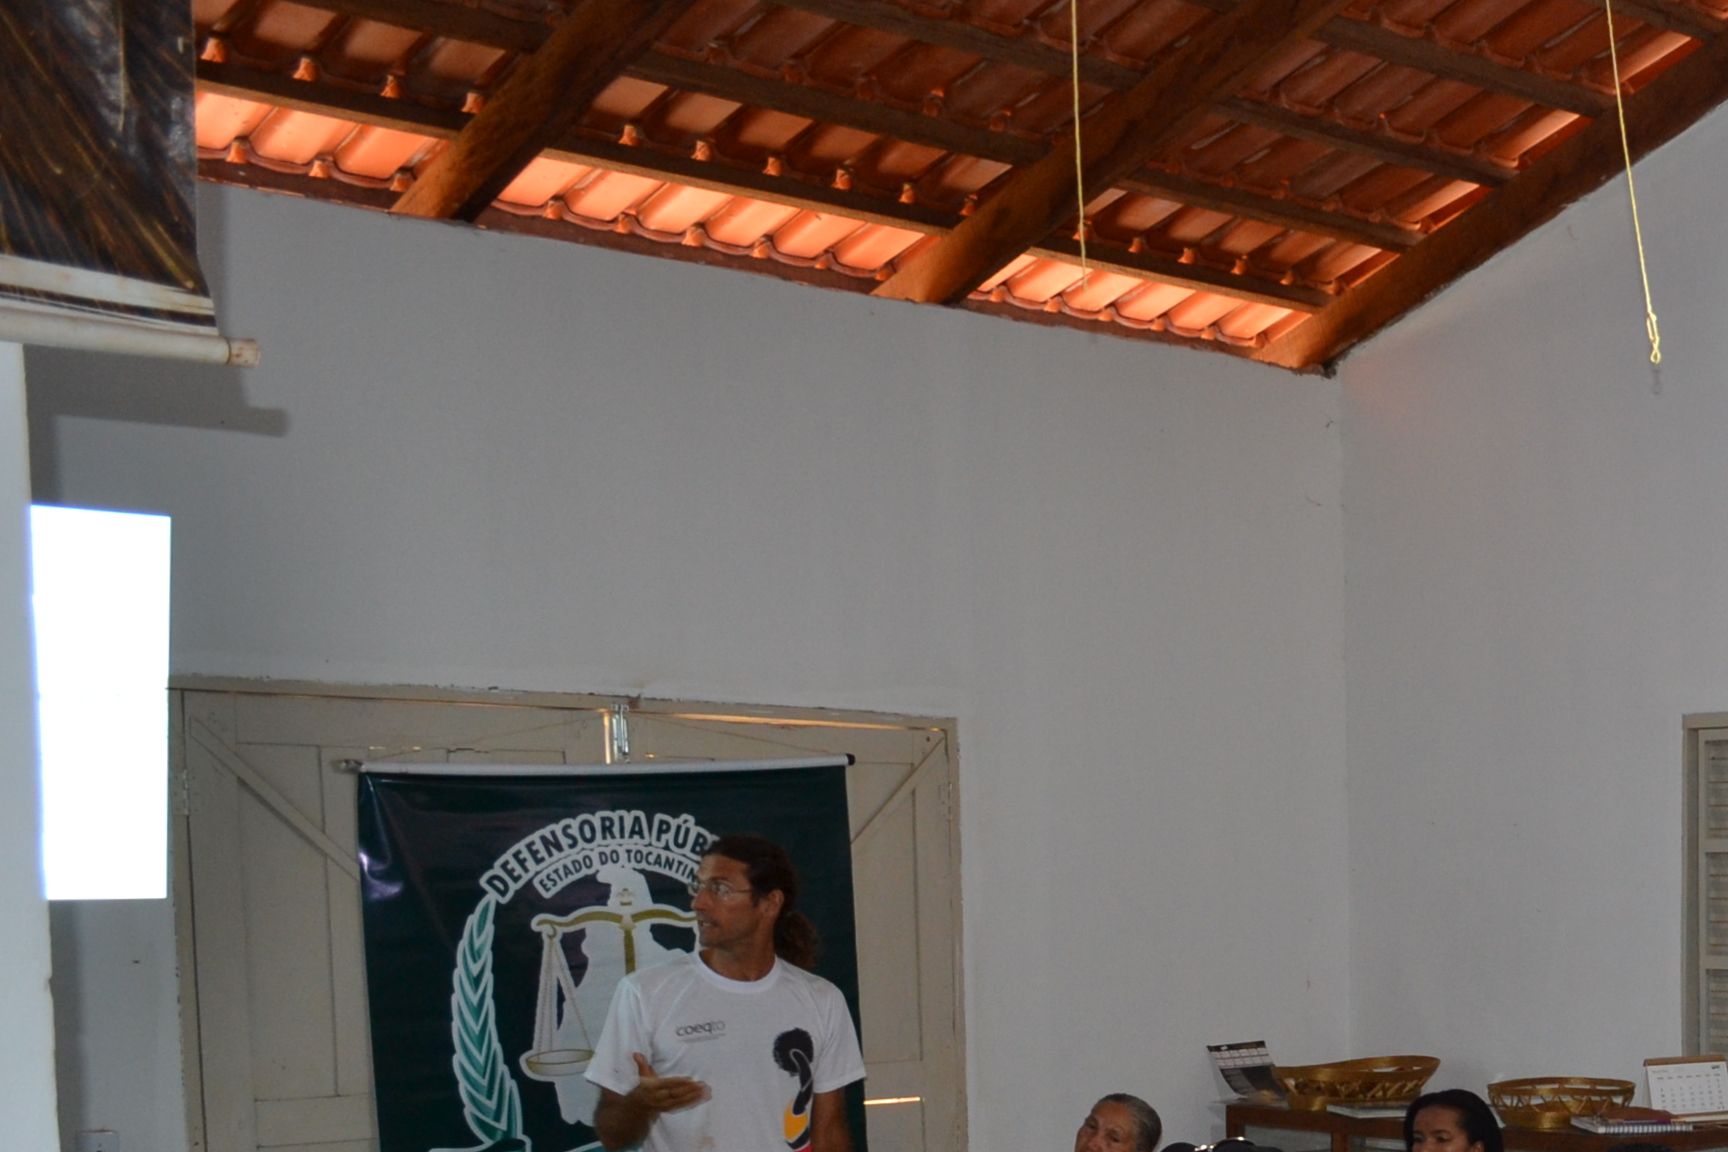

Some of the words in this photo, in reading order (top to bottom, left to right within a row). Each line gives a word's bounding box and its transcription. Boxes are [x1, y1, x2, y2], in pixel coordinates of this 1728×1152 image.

[486, 814, 646, 898] DEFENSORIA
[655, 818, 711, 856] PÚB
[538, 854, 594, 893] ESTADO
[598, 849, 620, 866] DO
[624, 849, 699, 883] TOCANTIN
